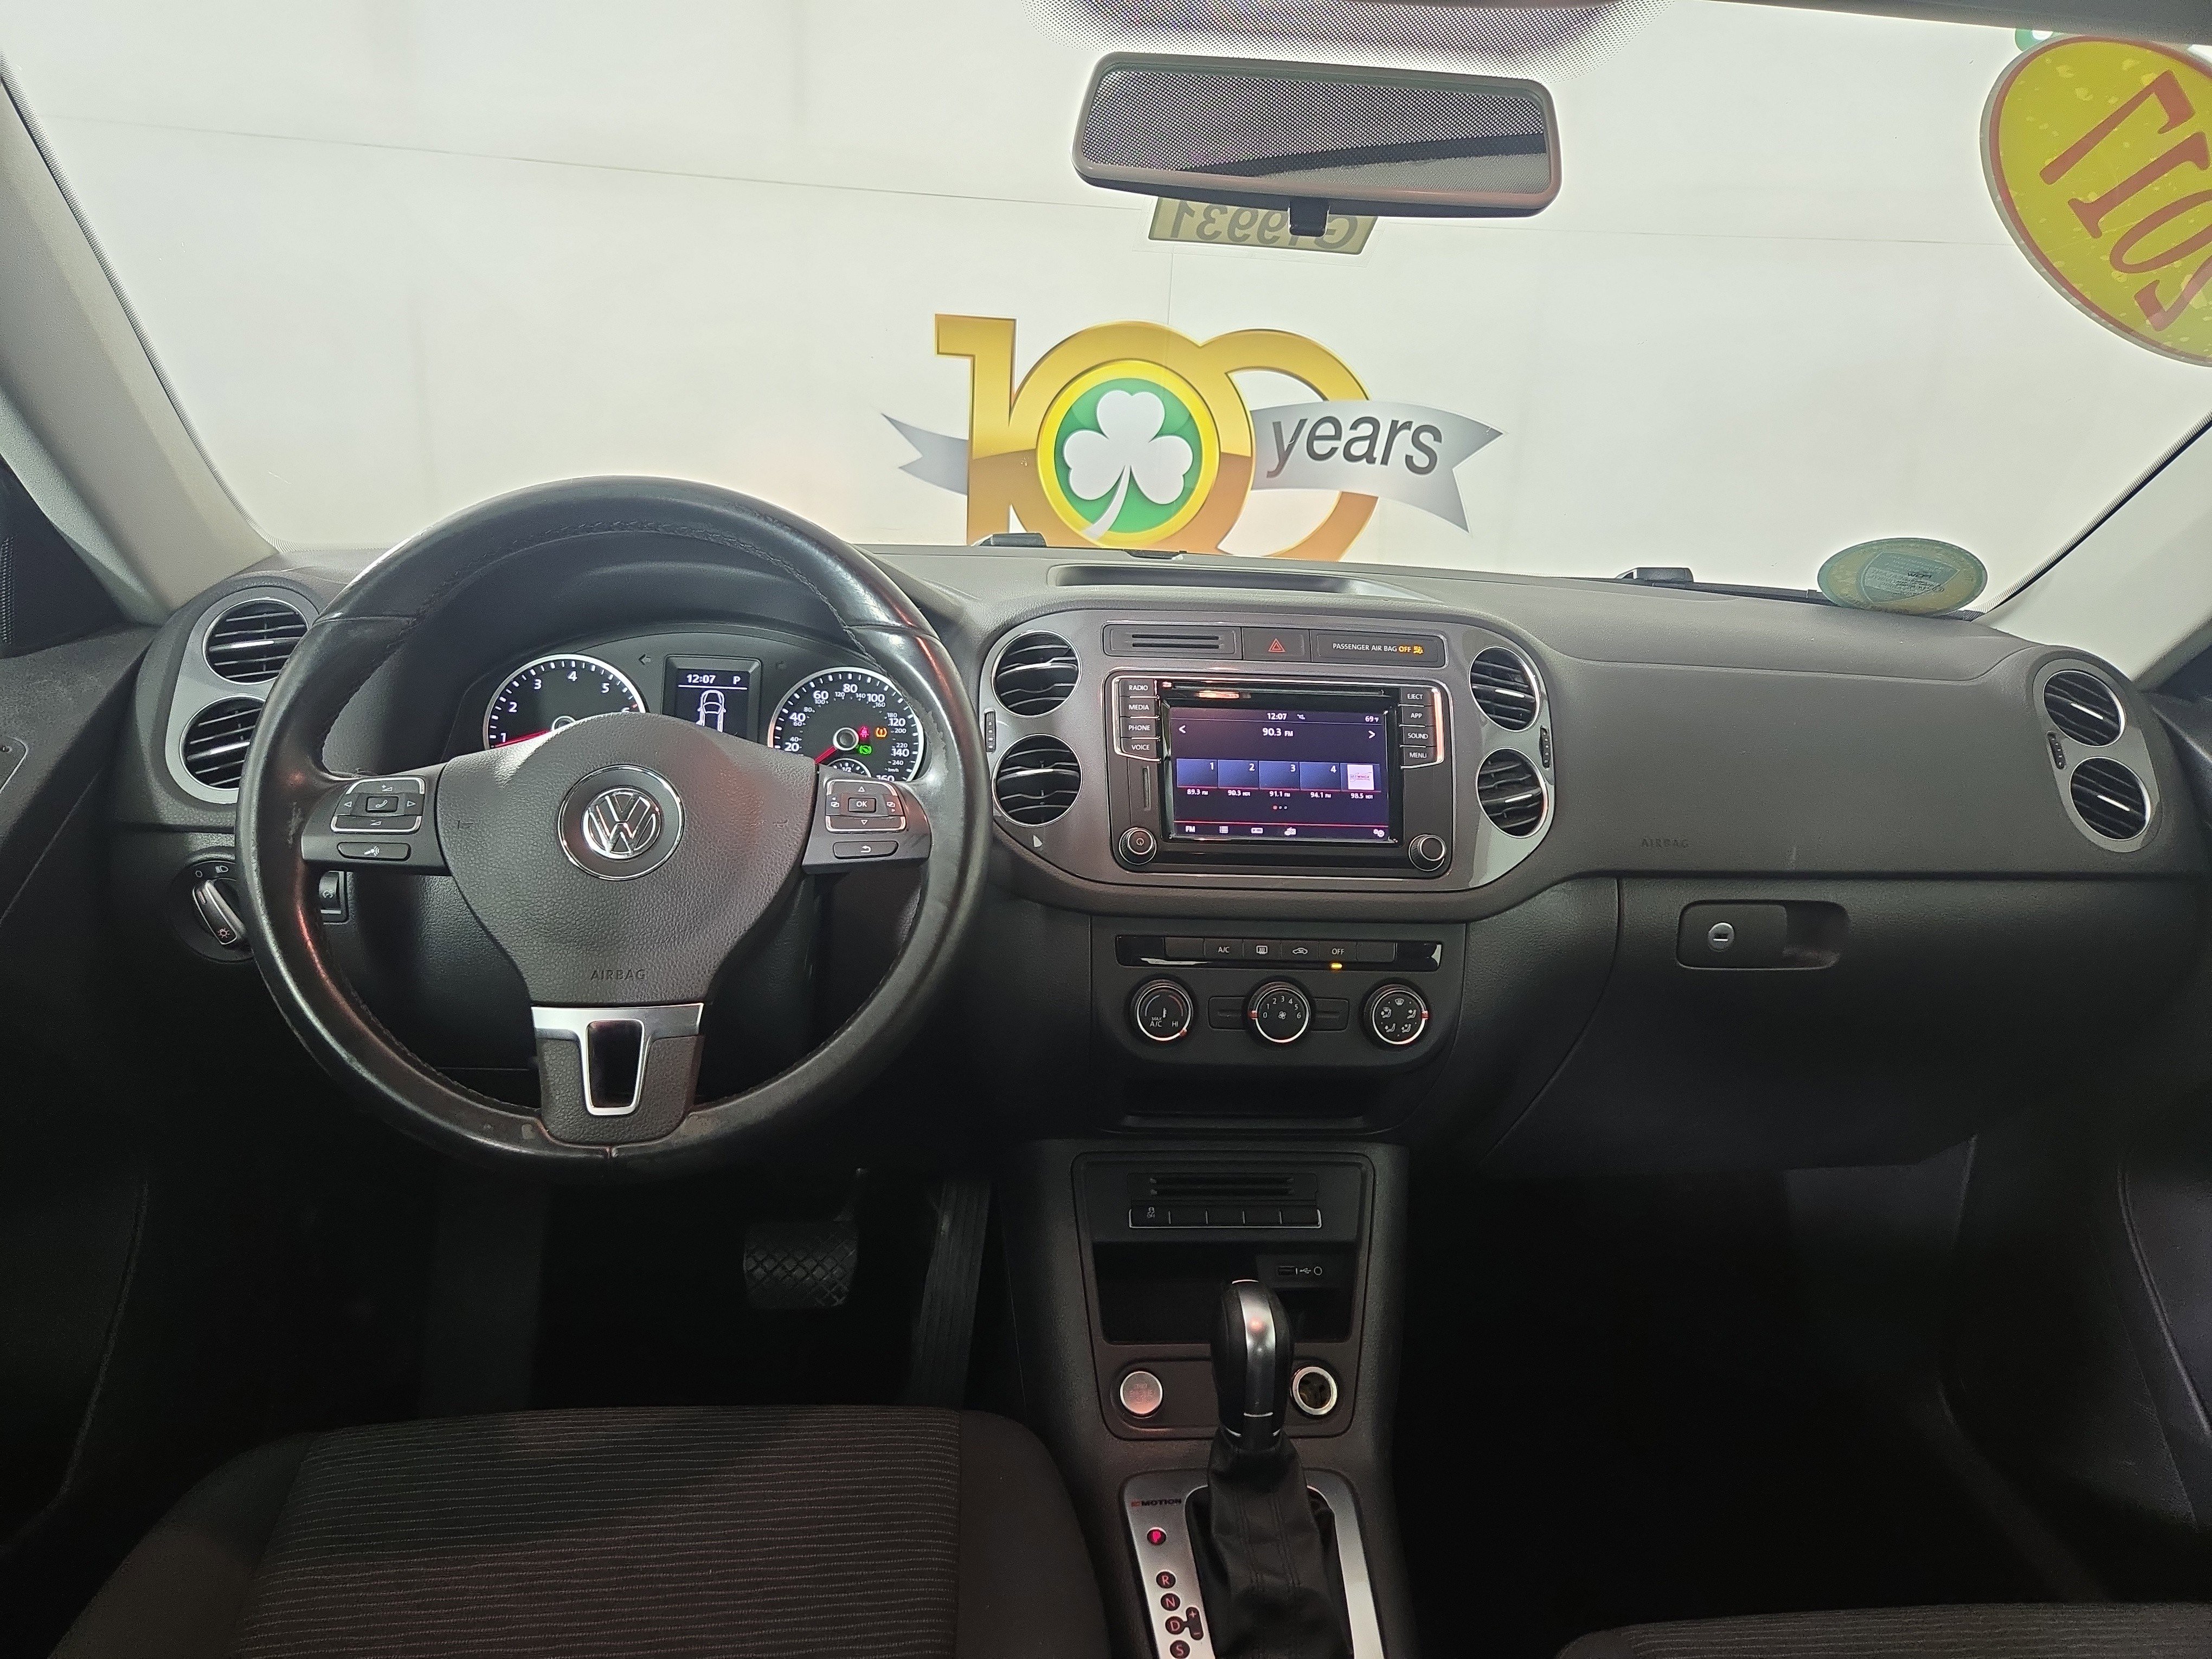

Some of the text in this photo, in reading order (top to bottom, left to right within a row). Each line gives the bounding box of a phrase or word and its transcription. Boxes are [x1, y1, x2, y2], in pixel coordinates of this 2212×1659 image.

[1266, 414, 1443, 479] years
[1332, 642, 1370, 651] PASSENGER
[568, 671, 578, 681] 4
[686, 674, 741, 685] 12:07 P
[533, 679, 542, 690] 3
[601, 683, 610, 693] 5
[843, 684, 858, 693] 80
[813, 690, 829, 700] 60
[866, 693, 885, 703] 100
[509, 702, 517, 713] 2
[789, 712, 806, 722] 40
[1267, 712, 1287, 721] 12:07
[889, 718, 906, 727] 120
[500, 732, 506, 743] 1
[1262, 728, 1282, 737] 90.3
[785, 742, 800, 752] 20
[892, 748, 910, 757] 140
[1210, 762, 1214, 770] 1
[1249, 763, 1256, 771] 2
[1290, 764, 1296, 773] 3
[1330, 765, 1337, 773] 4
[590, 969, 646, 980] AIRBAG
[1161, 1574, 1169, 1585] R
[1166, 1597, 1175, 1607] N
[1169, 1619, 1180, 1631] D
[1175, 1644, 1184, 1656] S
